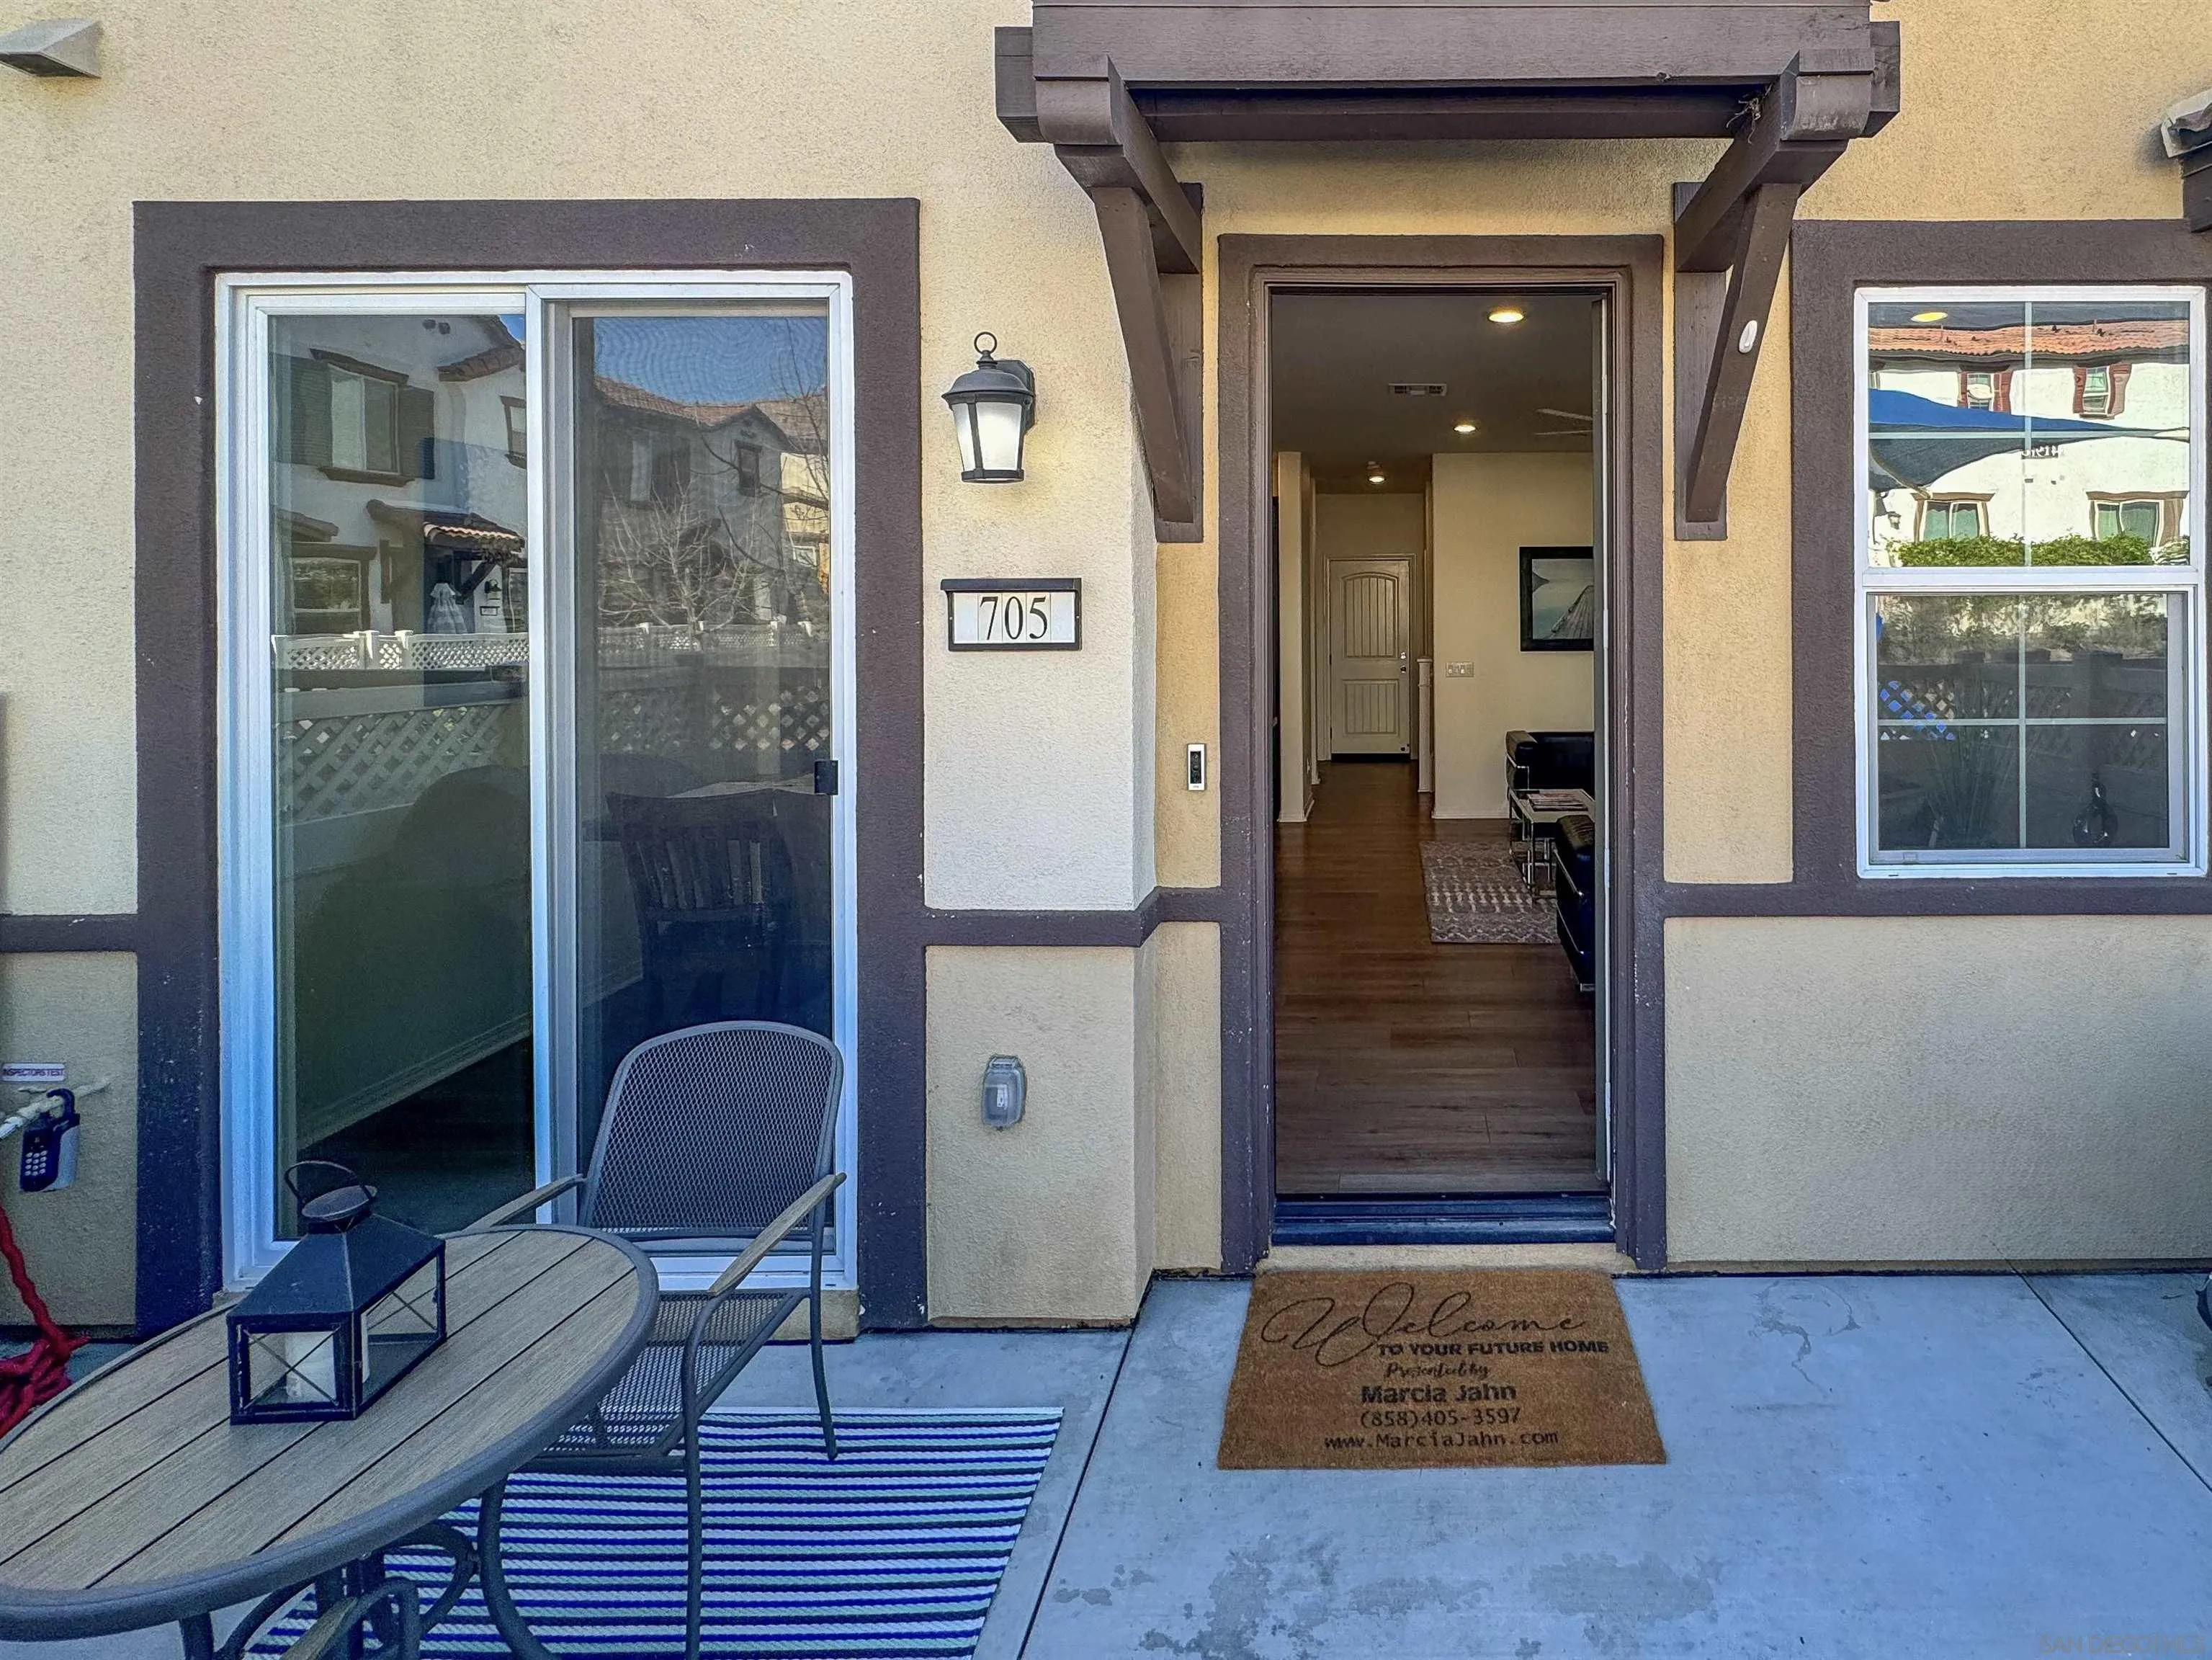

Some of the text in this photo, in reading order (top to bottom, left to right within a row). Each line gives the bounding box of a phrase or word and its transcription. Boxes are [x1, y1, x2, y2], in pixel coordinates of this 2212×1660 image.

[980, 596, 1047, 641] 705
[1261, 1282, 1585, 1367] Welcome
[1377, 1341, 1609, 1356] TO YOUR FUTURE HOME
[1361, 1383, 1517, 1403] Marcia Jahn
[1361, 1407, 1521, 1428] (858)405-3597
[1325, 1430, 1559, 1449] www.MarciaJahn.com
